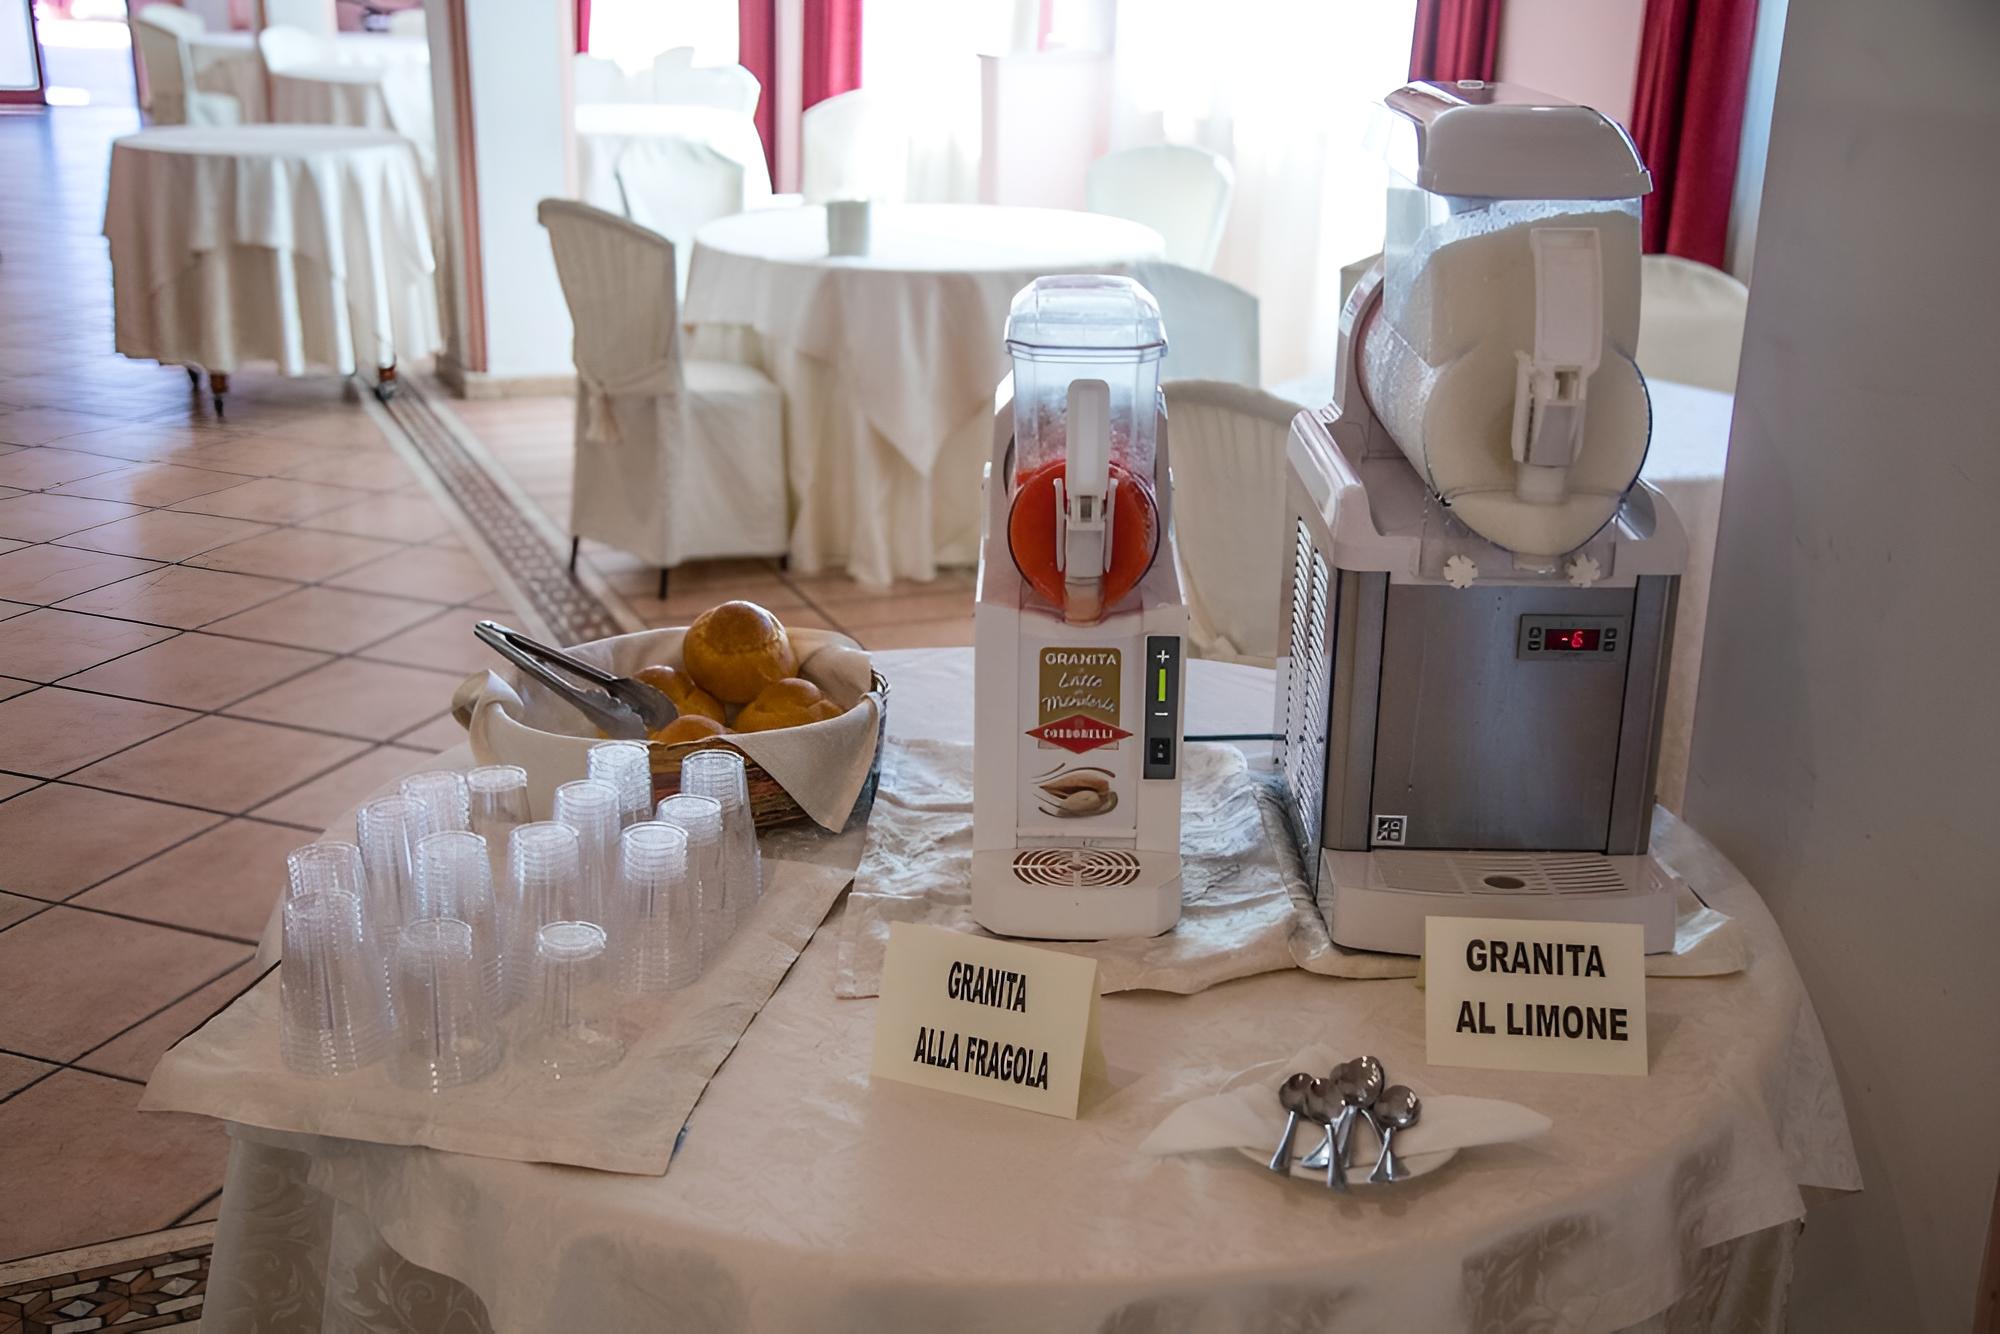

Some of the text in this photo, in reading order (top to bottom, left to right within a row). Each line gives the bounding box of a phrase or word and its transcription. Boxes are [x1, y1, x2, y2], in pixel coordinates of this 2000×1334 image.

[1045, 652, 1117, 665] GRANITA
[1465, 938, 1606, 978] GRANITA
[948, 960, 1026, 1013] GRANITA
[1455, 1000, 1629, 1041] AL LIMONE
[913, 1026, 1049, 1091] ALLA FRAGOLA
